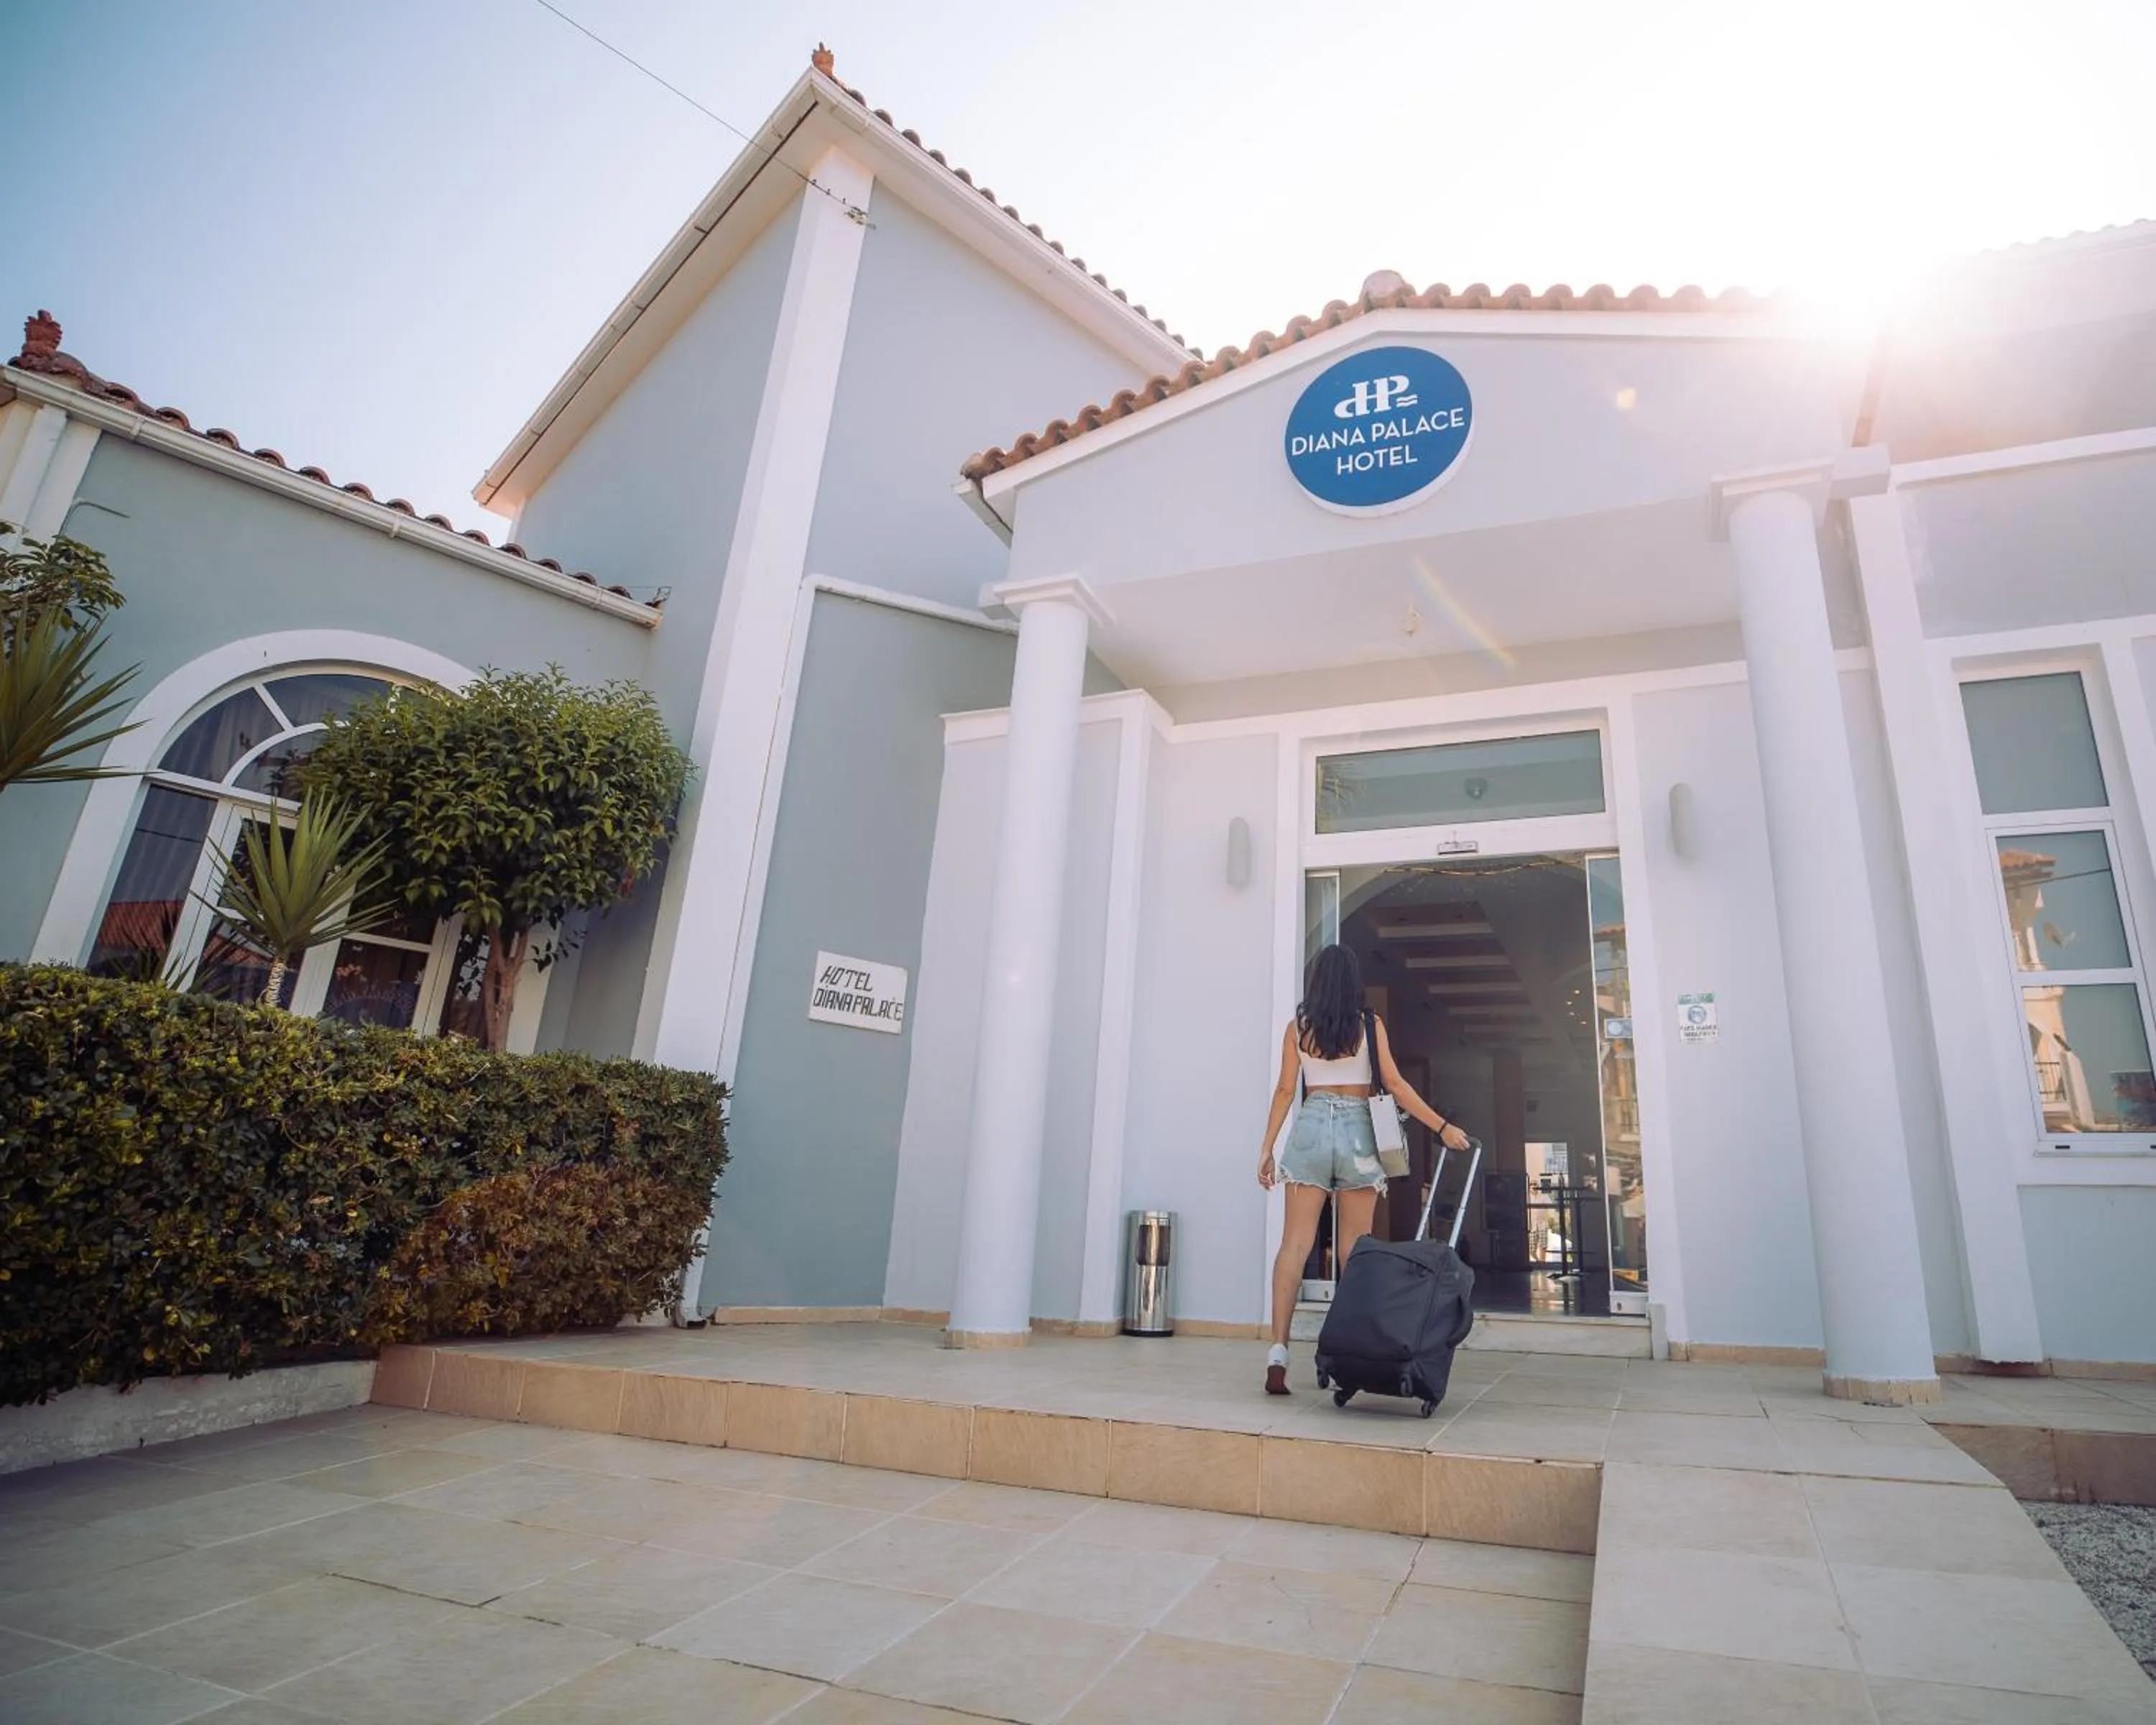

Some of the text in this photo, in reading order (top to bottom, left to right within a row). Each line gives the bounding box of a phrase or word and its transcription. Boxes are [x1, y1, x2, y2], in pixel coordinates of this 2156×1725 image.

[1291, 407, 1465, 456] DIANA PALACE
[1337, 444, 1418, 475] HOTEL
[819, 965, 873, 992] HOTEL
